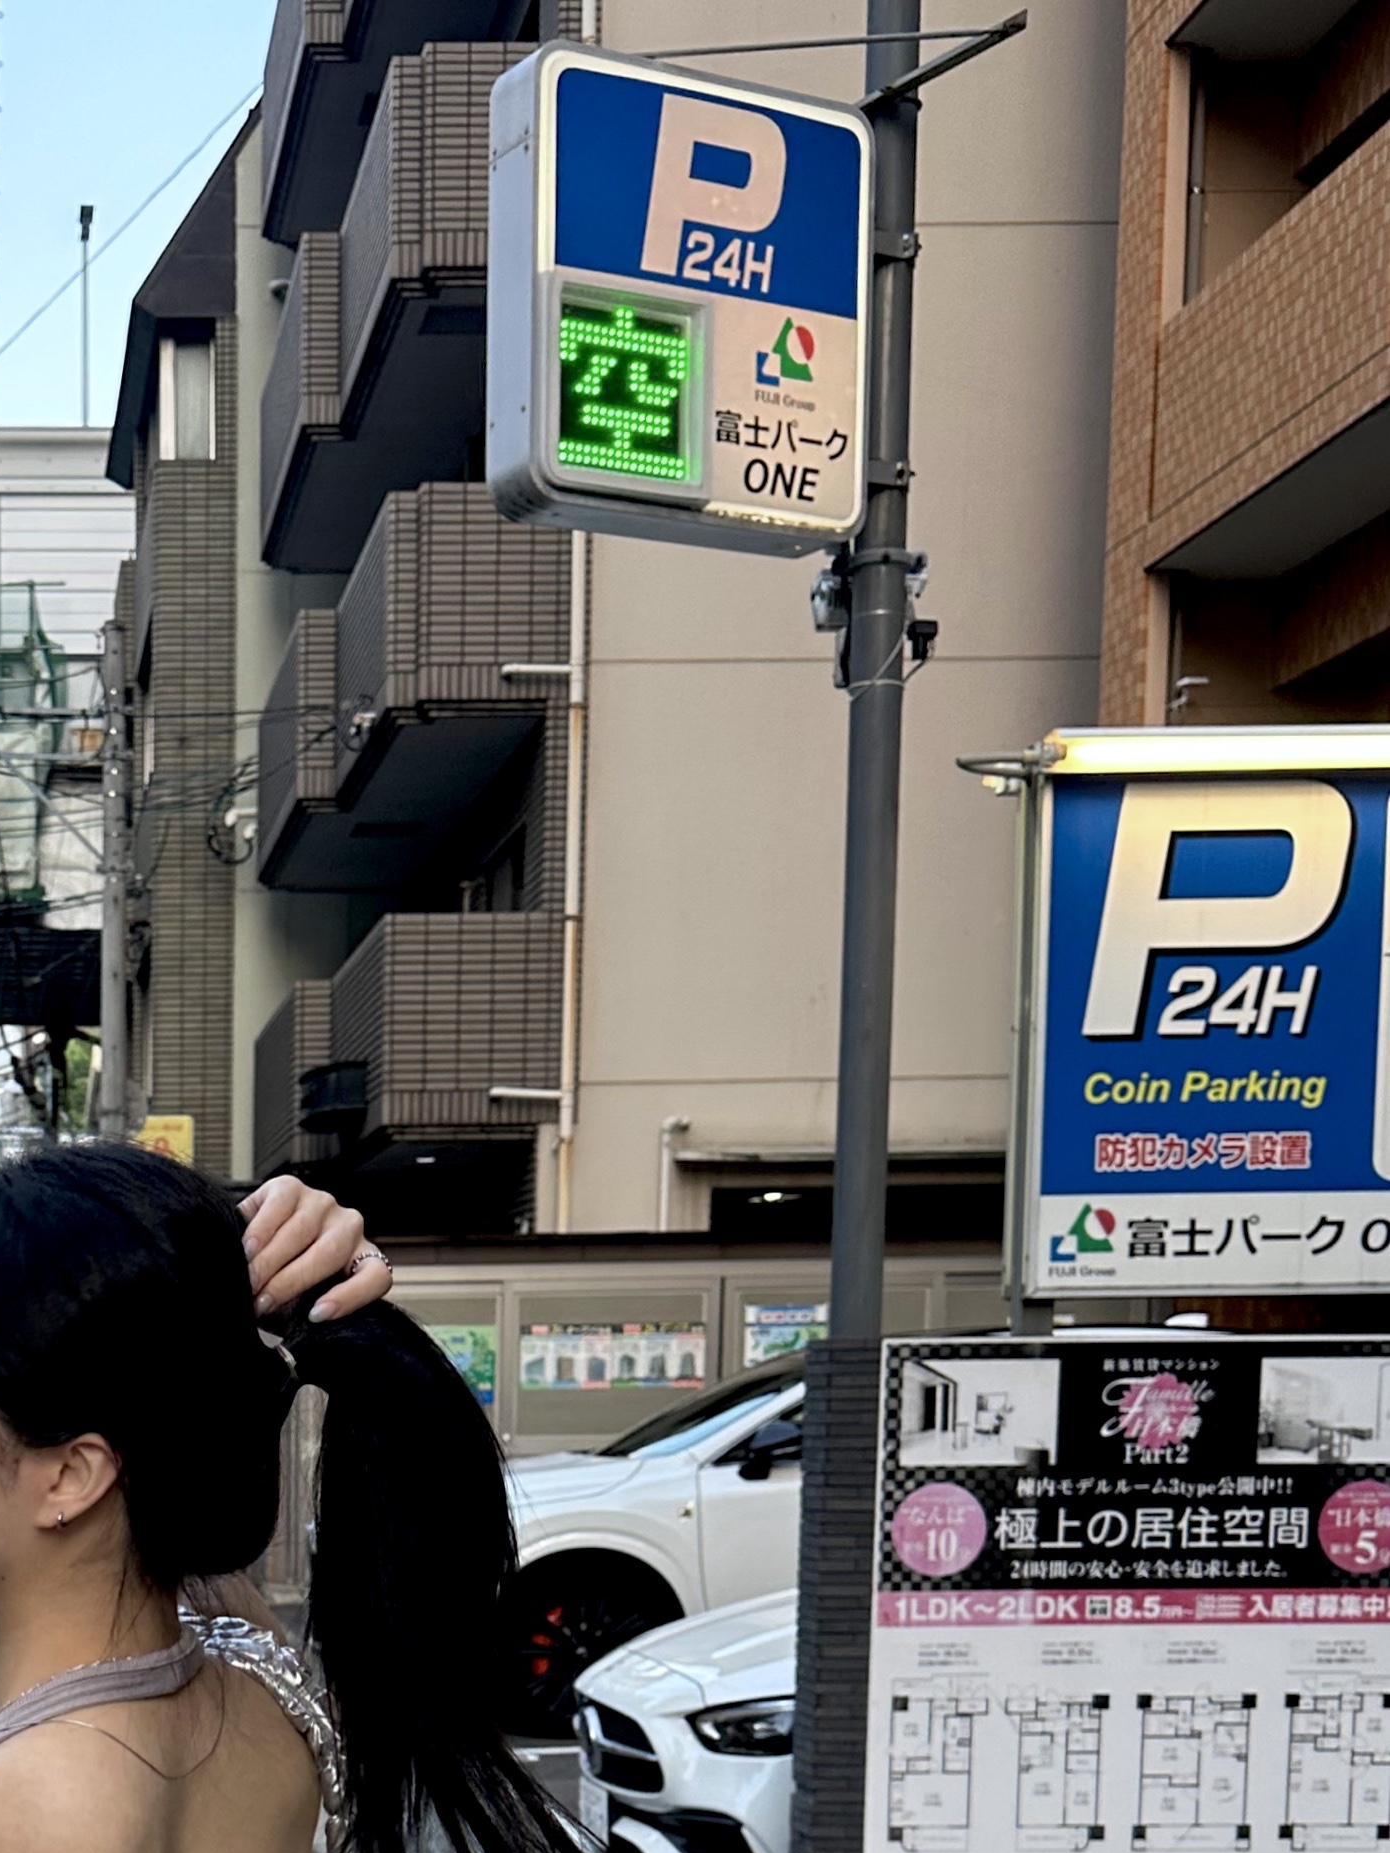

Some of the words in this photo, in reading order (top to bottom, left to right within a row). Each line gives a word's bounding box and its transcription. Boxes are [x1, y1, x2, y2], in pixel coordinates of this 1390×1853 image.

[640, 93, 787, 276] P
[682, 230, 774, 293] 24H
[559, 306, 688, 481] 空
[714, 409, 849, 461] 富士パーク
[743, 458, 820, 502] ONE
[1081, 779, 1354, 1036] P
[1157, 965, 1319, 1036] 24H
[1083, 1072, 1171, 1104] Coin
[1180, 1070, 1327, 1109] Parking
[1095, 1132, 1311, 1172] 防犯カメラ設置
[1127, 1214, 1345, 1258] 富士パーク
[1122, 1442, 1191, 1465] Part2
[927, 1528, 959, 1562] 10
[994, 1505, 1310, 1550] 極上の居住空間
[1354, 1530, 1378, 1565] 5
[1247, 1593, 1390, 1619] 入居者募集中
